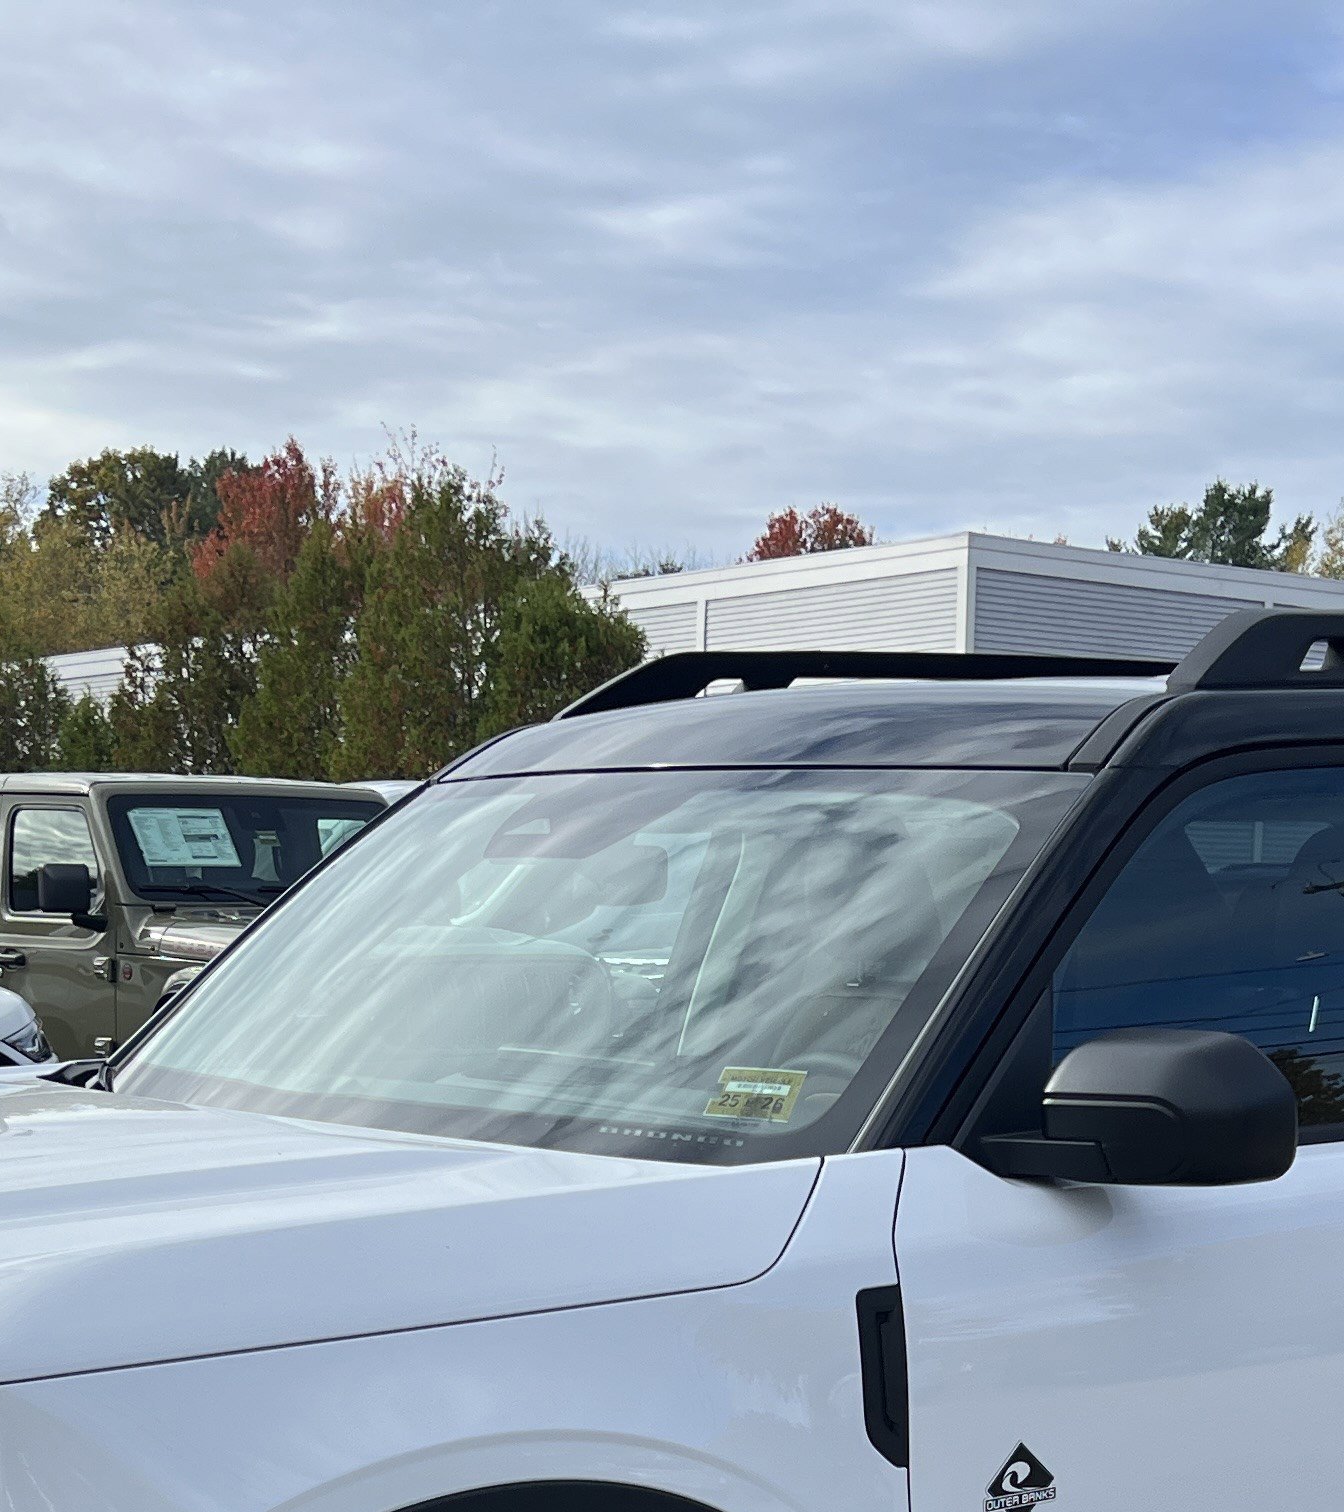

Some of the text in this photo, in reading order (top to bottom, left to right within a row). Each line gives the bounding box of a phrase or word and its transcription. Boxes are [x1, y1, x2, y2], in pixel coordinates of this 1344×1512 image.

[718, 1093, 741, 1108] 25
[986, 1488, 1055, 1511] OUTER BANKS
